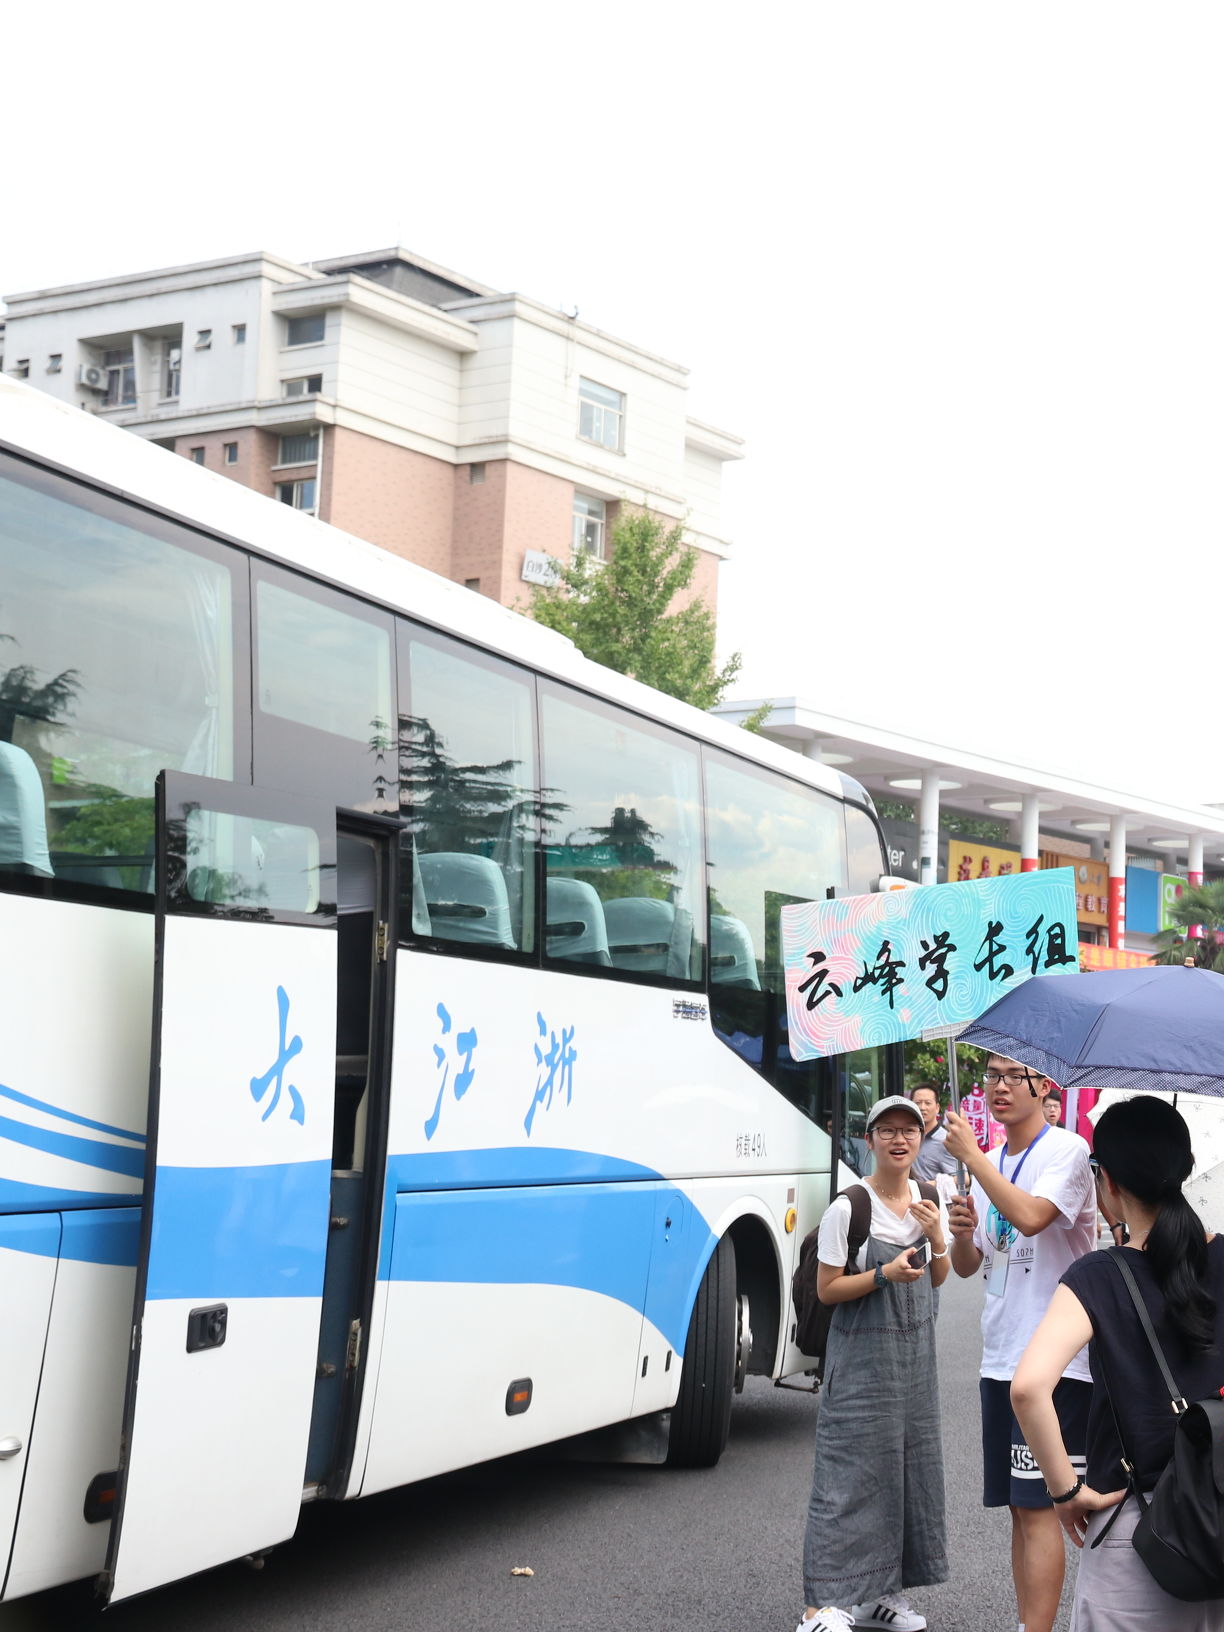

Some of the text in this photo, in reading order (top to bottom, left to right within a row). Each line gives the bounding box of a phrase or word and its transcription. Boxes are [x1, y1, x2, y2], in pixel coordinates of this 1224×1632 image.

[798, 914, 1076, 1011] 云峰学长组
[735, 1131, 767, 1158] 核载49人
